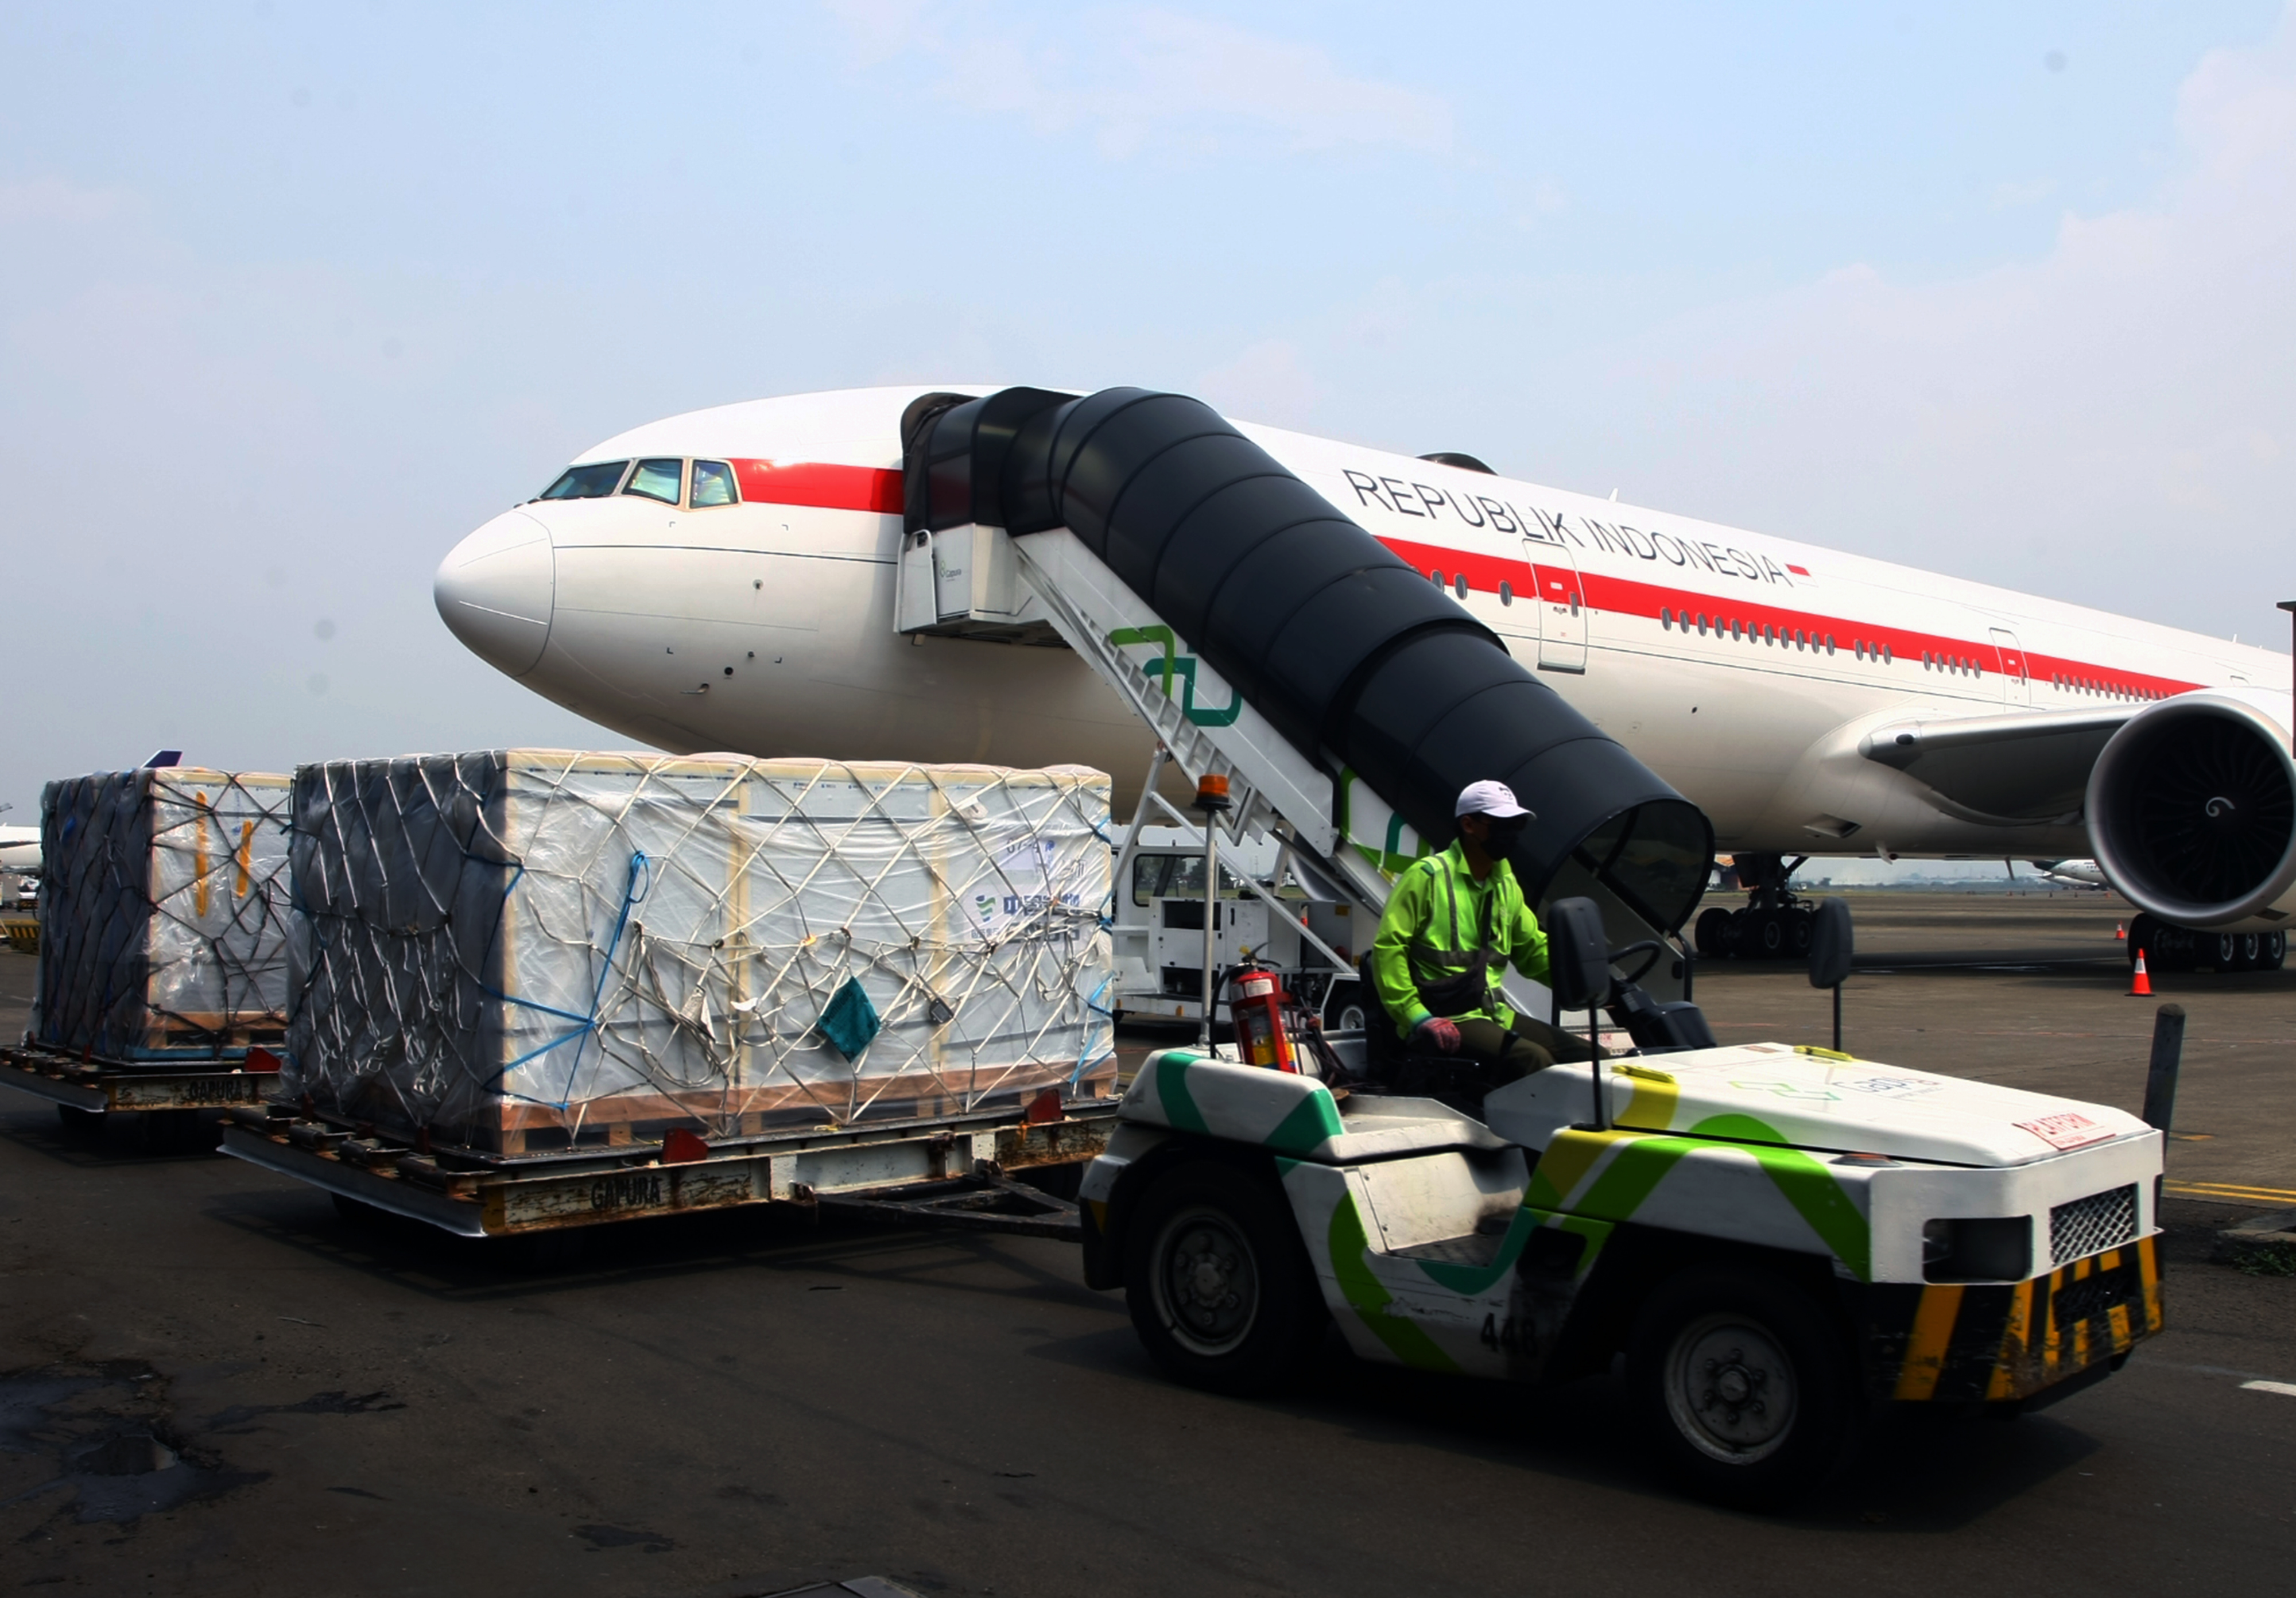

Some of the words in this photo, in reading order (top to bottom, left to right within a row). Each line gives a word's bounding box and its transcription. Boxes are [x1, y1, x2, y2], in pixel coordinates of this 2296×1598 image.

[1342, 468, 1585, 548] REPUBLIK
[1580, 517, 1793, 587] INDONESIA
[2020, 1112, 2097, 1138] PLATFORM
[591, 1176, 661, 1209] GAPURA
[1480, 1313, 1538, 1358] 448
